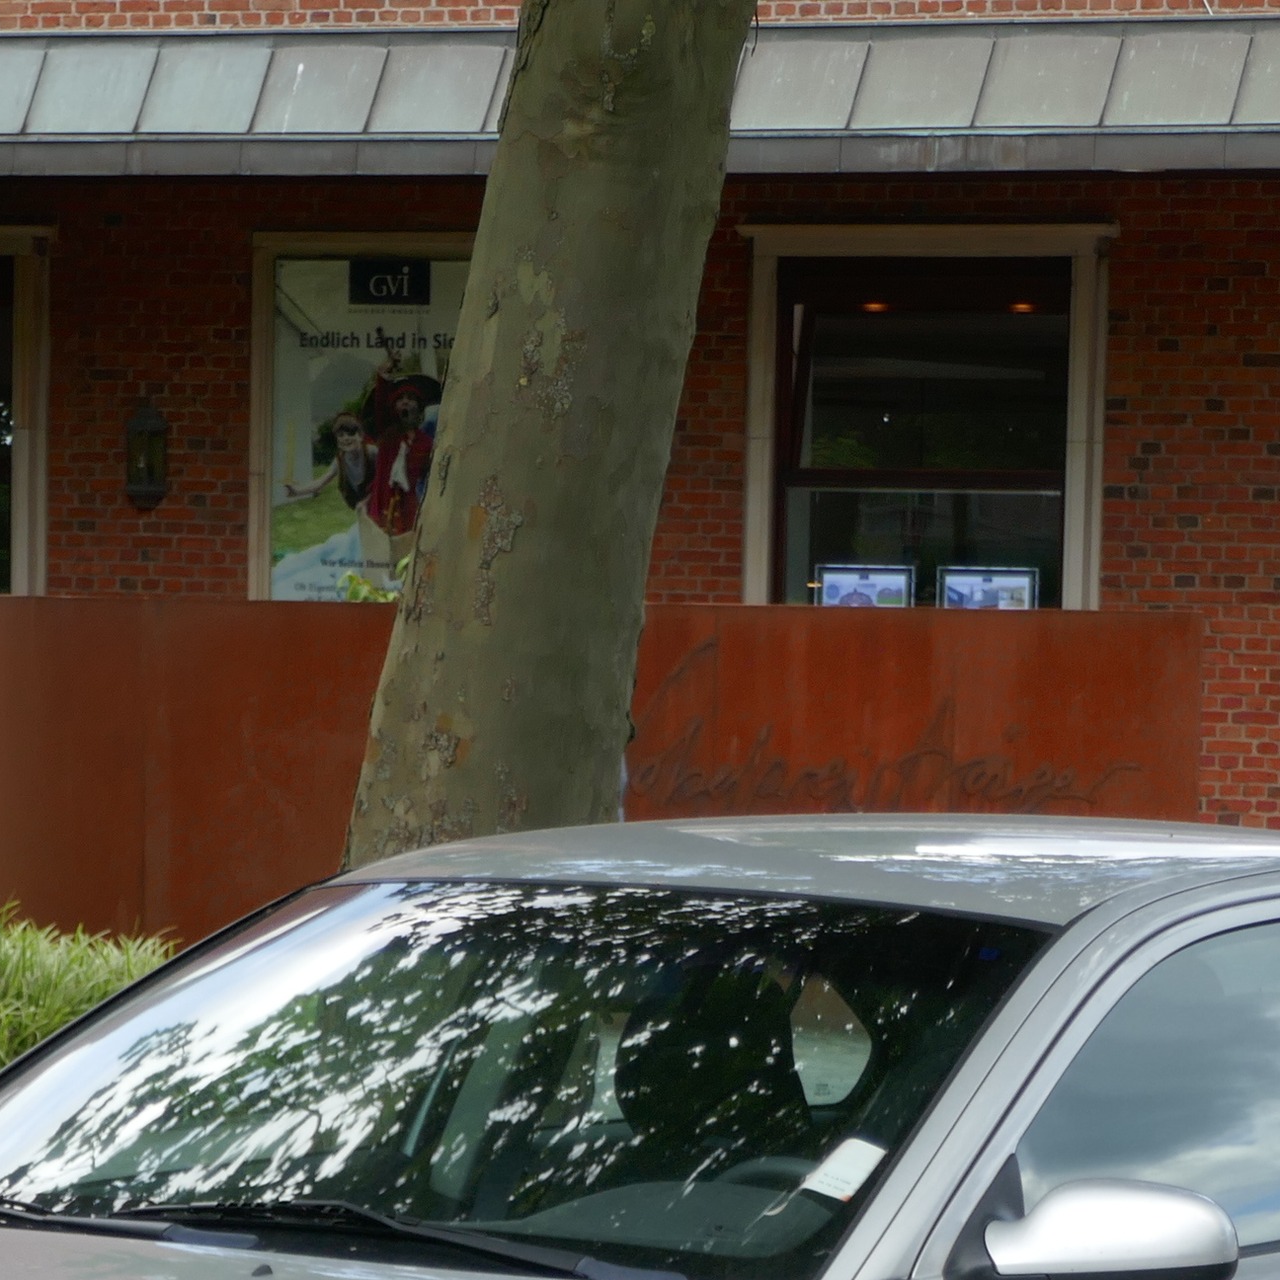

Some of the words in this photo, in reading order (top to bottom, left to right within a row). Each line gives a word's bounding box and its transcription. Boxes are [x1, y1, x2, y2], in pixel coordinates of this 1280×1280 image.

[298, 331, 360, 349] Endlich
[366, 331, 406, 349] Land
[411, 331, 427, 349] in
